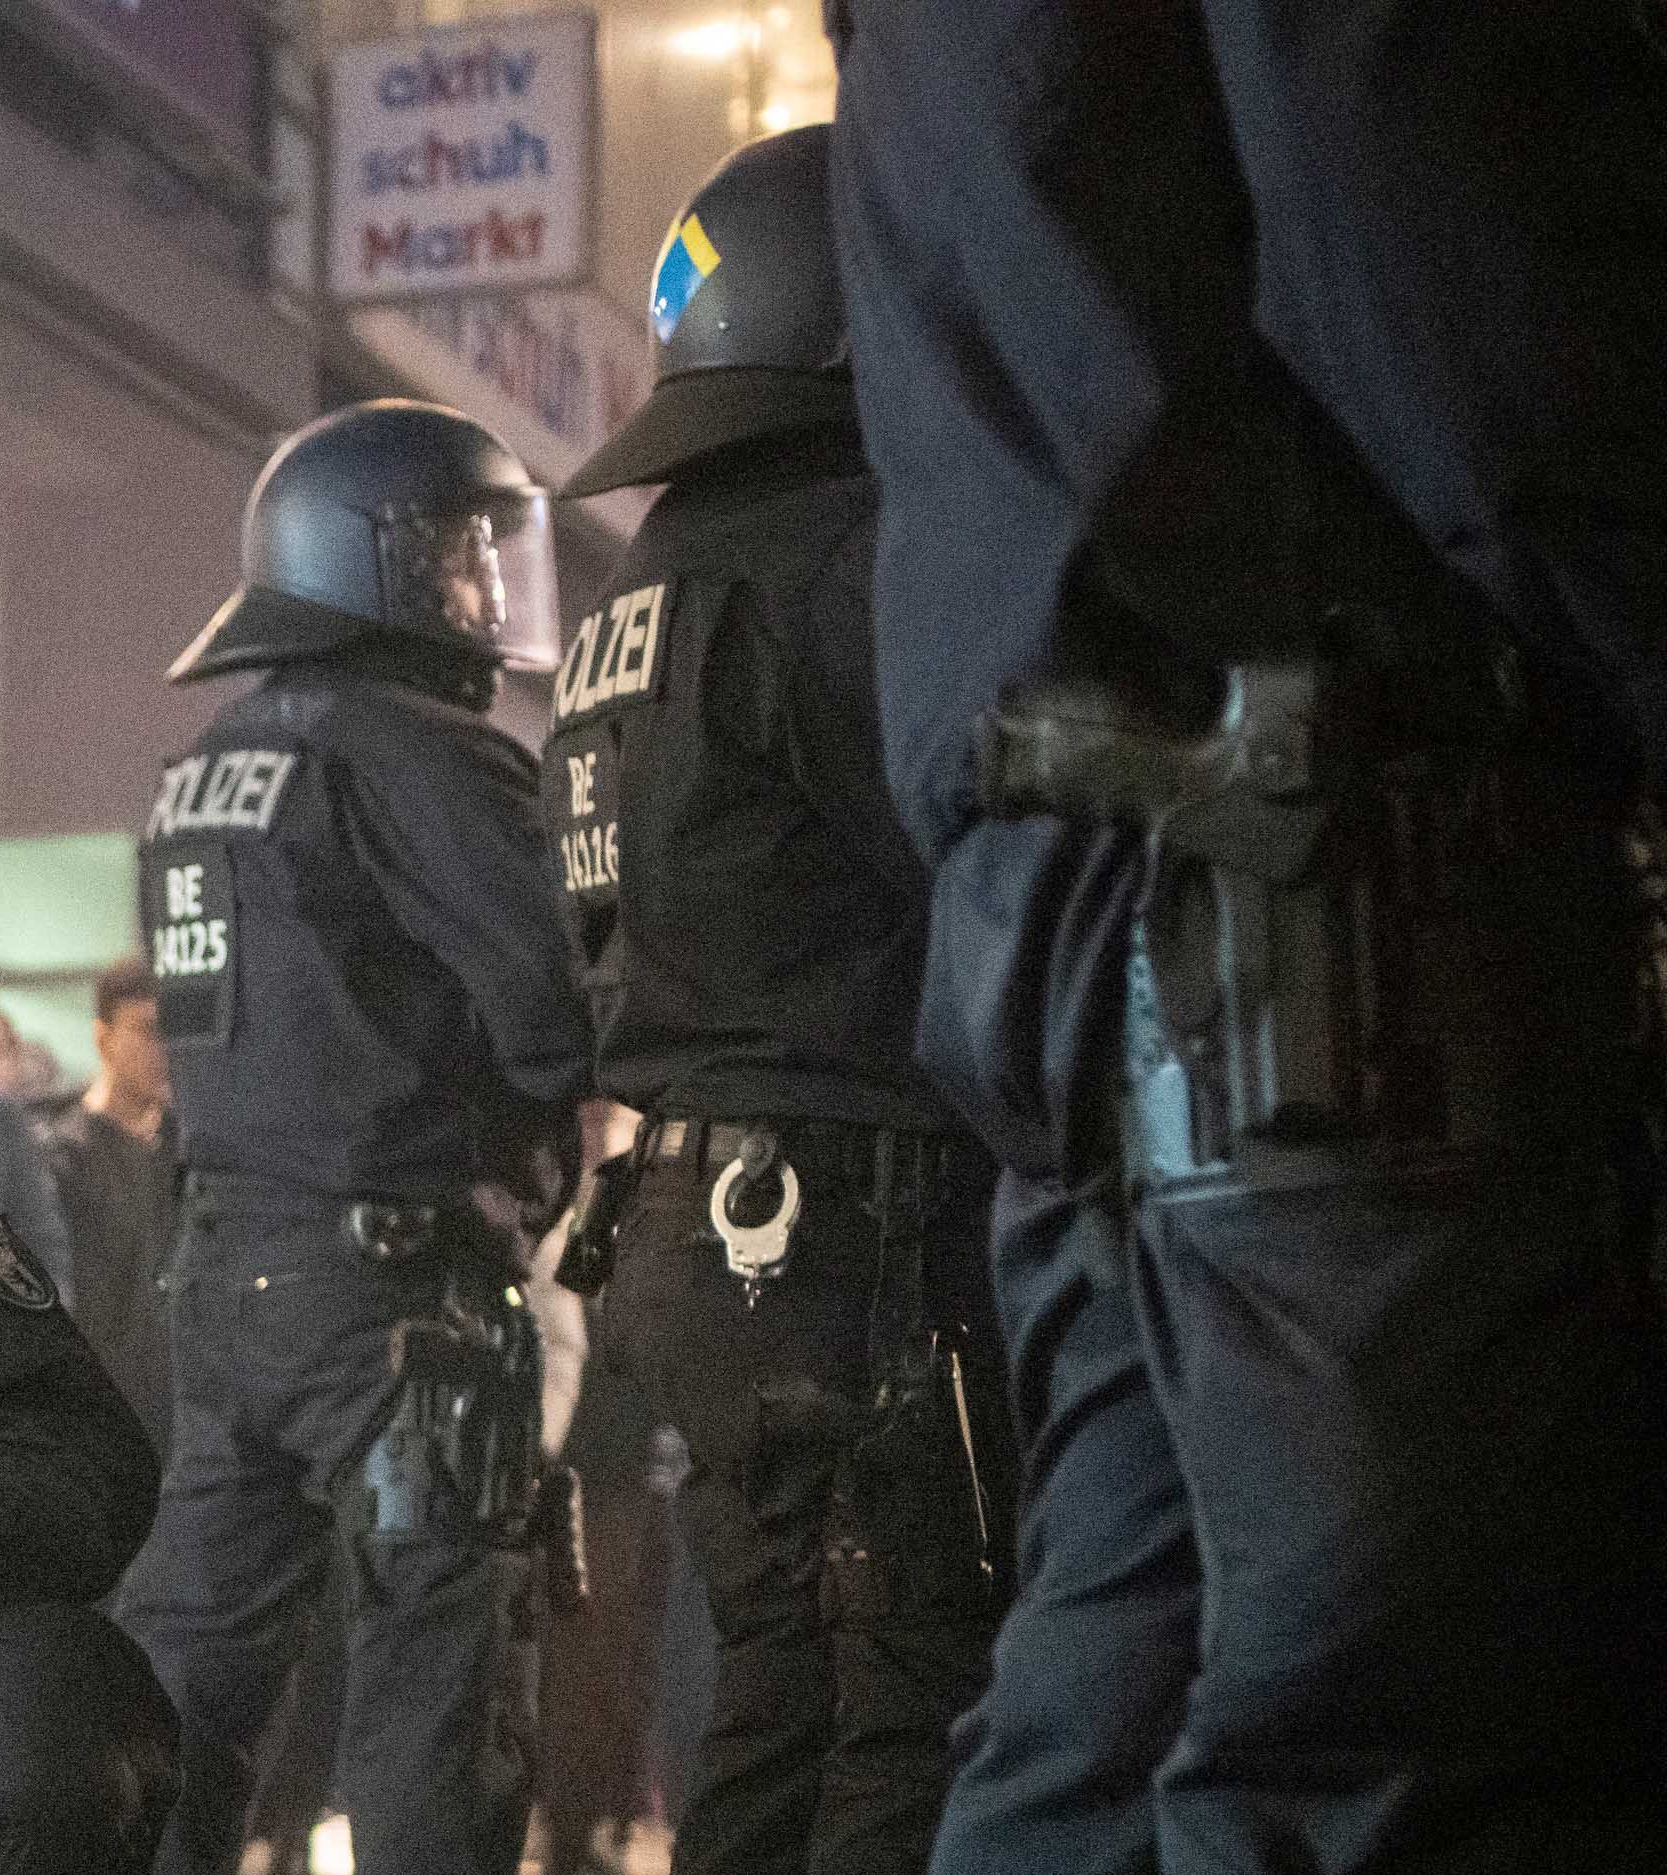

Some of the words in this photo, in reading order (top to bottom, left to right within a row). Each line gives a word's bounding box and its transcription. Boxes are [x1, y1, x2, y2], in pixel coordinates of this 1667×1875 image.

[377, 44, 535, 110] aktiv
[361, 122, 548, 196] schuh
[359, 205, 544, 277] Markt
[568, 752, 596, 818] BE
[167, 862, 205, 920] BE
